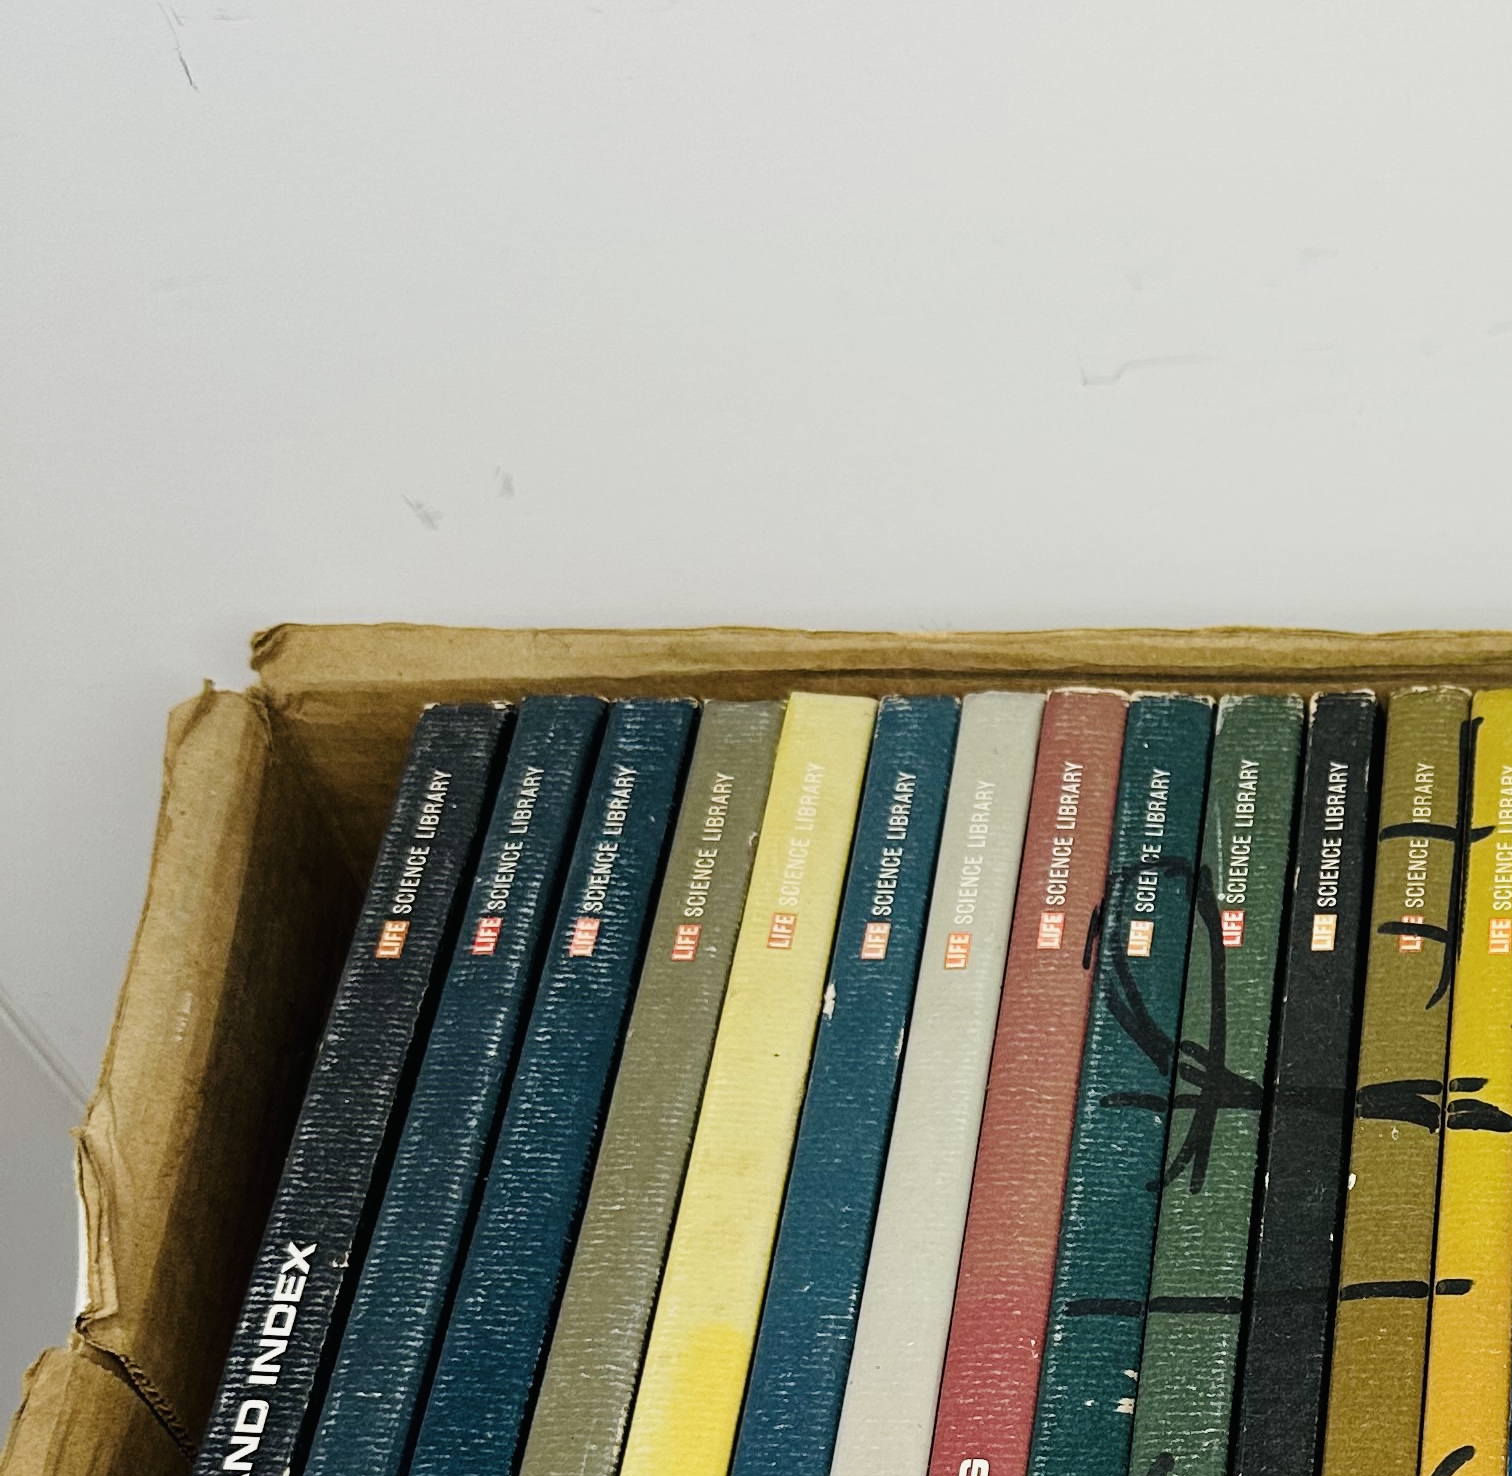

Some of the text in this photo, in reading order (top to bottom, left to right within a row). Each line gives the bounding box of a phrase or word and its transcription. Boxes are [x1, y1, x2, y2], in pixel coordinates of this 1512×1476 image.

[377, 769, 453, 958] LIFE SCIENCE LIBRARY
[472, 765, 545, 955] LIFE SCIENCE LIBRARY
[569, 764, 637, 956] LIFE SCIENCE LIBRARY
[672, 772, 735, 961] LIFE SCIENCE LIBRARY
[768, 762, 826, 948] LIFE SCIENCE LIBRARY
[861, 771, 917, 959] LIFE SCIENCE LIBRARY
[944, 779, 996, 969] LIFE SCIENCE LIBRARY
[1037, 762, 1084, 949] LIFE SCIENCE LIBRARY
[1127, 921, 1153, 956] LIFE
[1145, 768, 1171, 837] LIBRARY
[1221, 759, 1260, 946] LIFE SCIENCE LIBRARY
[1311, 762, 1349, 950] LIFE SCIENCE LIBRARY
[1406, 838, 1429, 908] SCIENCE
[1412, 763, 1436, 832] IBRARY
[1489, 918, 1512, 953] LIFE
[249, 1242, 316, 1385] INDEX
